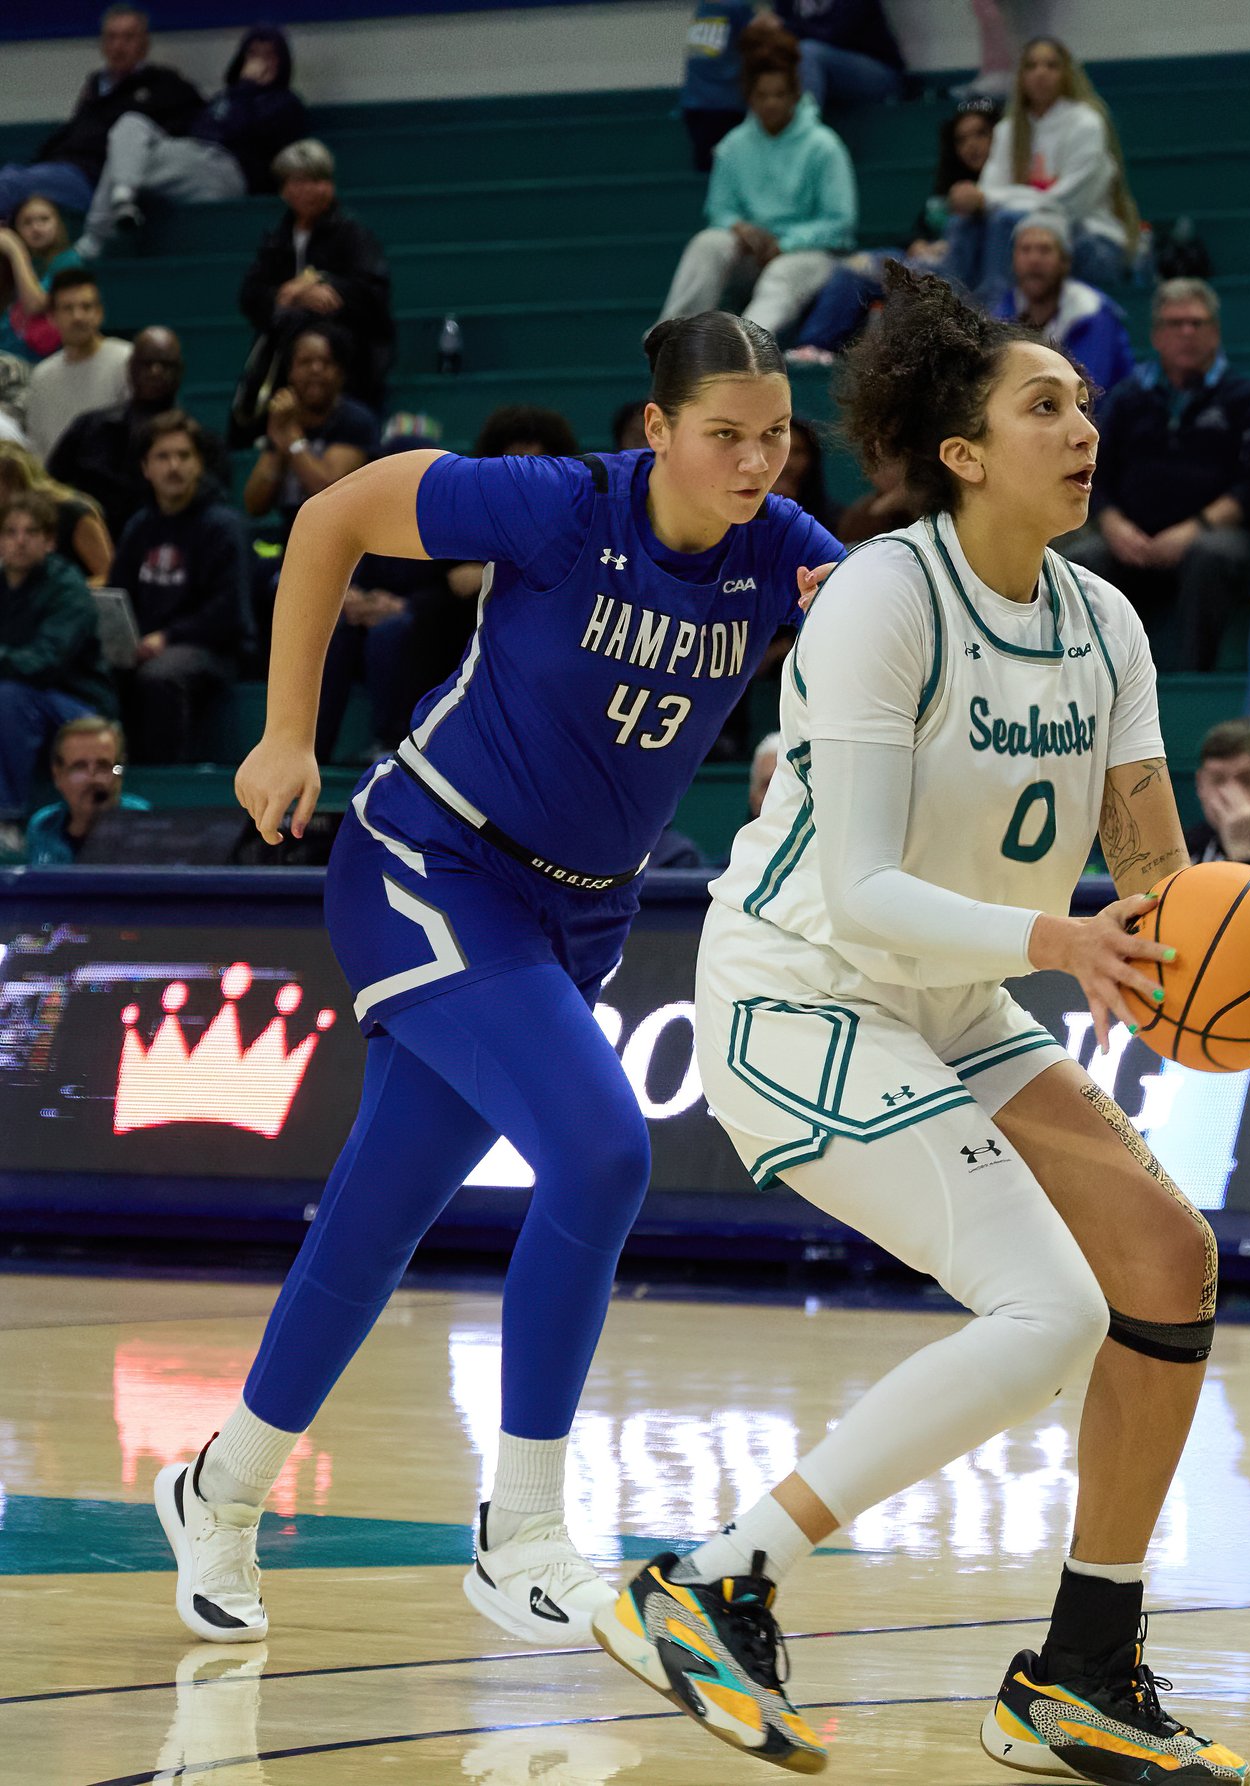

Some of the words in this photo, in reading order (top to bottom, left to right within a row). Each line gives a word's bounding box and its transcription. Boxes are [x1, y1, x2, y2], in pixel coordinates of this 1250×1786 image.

[722, 577, 757, 594] CAA
[1067, 643, 1092, 659] CAA
[606, 684, 692, 750] 43
[1001, 779, 1056, 864] 0
